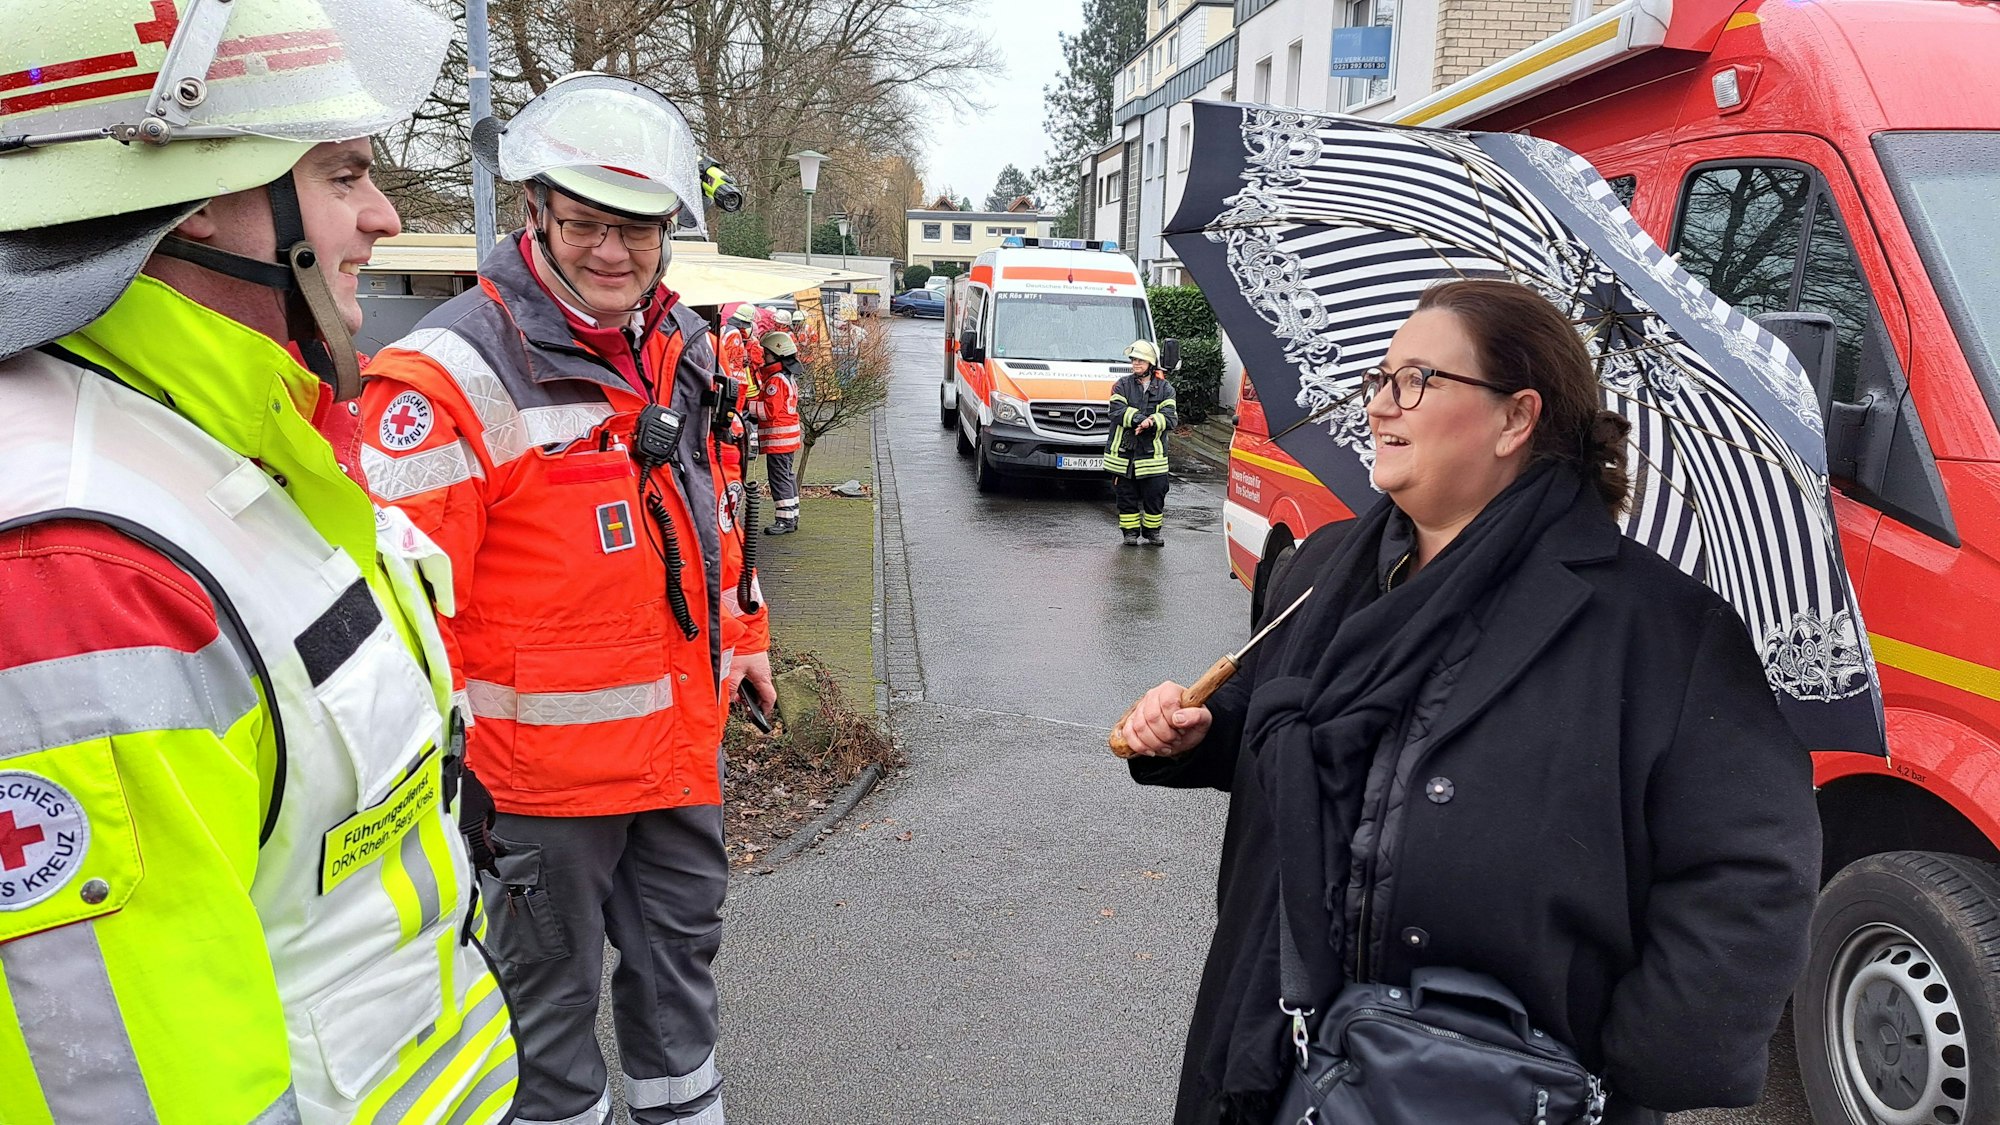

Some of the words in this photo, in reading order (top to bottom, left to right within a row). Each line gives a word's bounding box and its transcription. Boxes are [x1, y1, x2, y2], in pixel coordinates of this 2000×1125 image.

[1052, 239, 1071, 248] DRK
[1025, 282, 1062, 290] Deutsches
[997, 292, 1008, 300] RK
[387, 395, 428, 418] DEUTSCHES
[382, 418, 395, 444] ROTES
[397, 423, 426, 446] KREUZ
[1062, 457, 1073, 467] GL
[1078, 458, 1088, 467] RK
[1911, 769, 1927, 783] bar
[343, 772, 429, 850] Führungsdienst
[331, 849, 359, 878] DRK
[415, 786, 434, 814] Kreis
[22, 831, 76, 893] KREUZ
